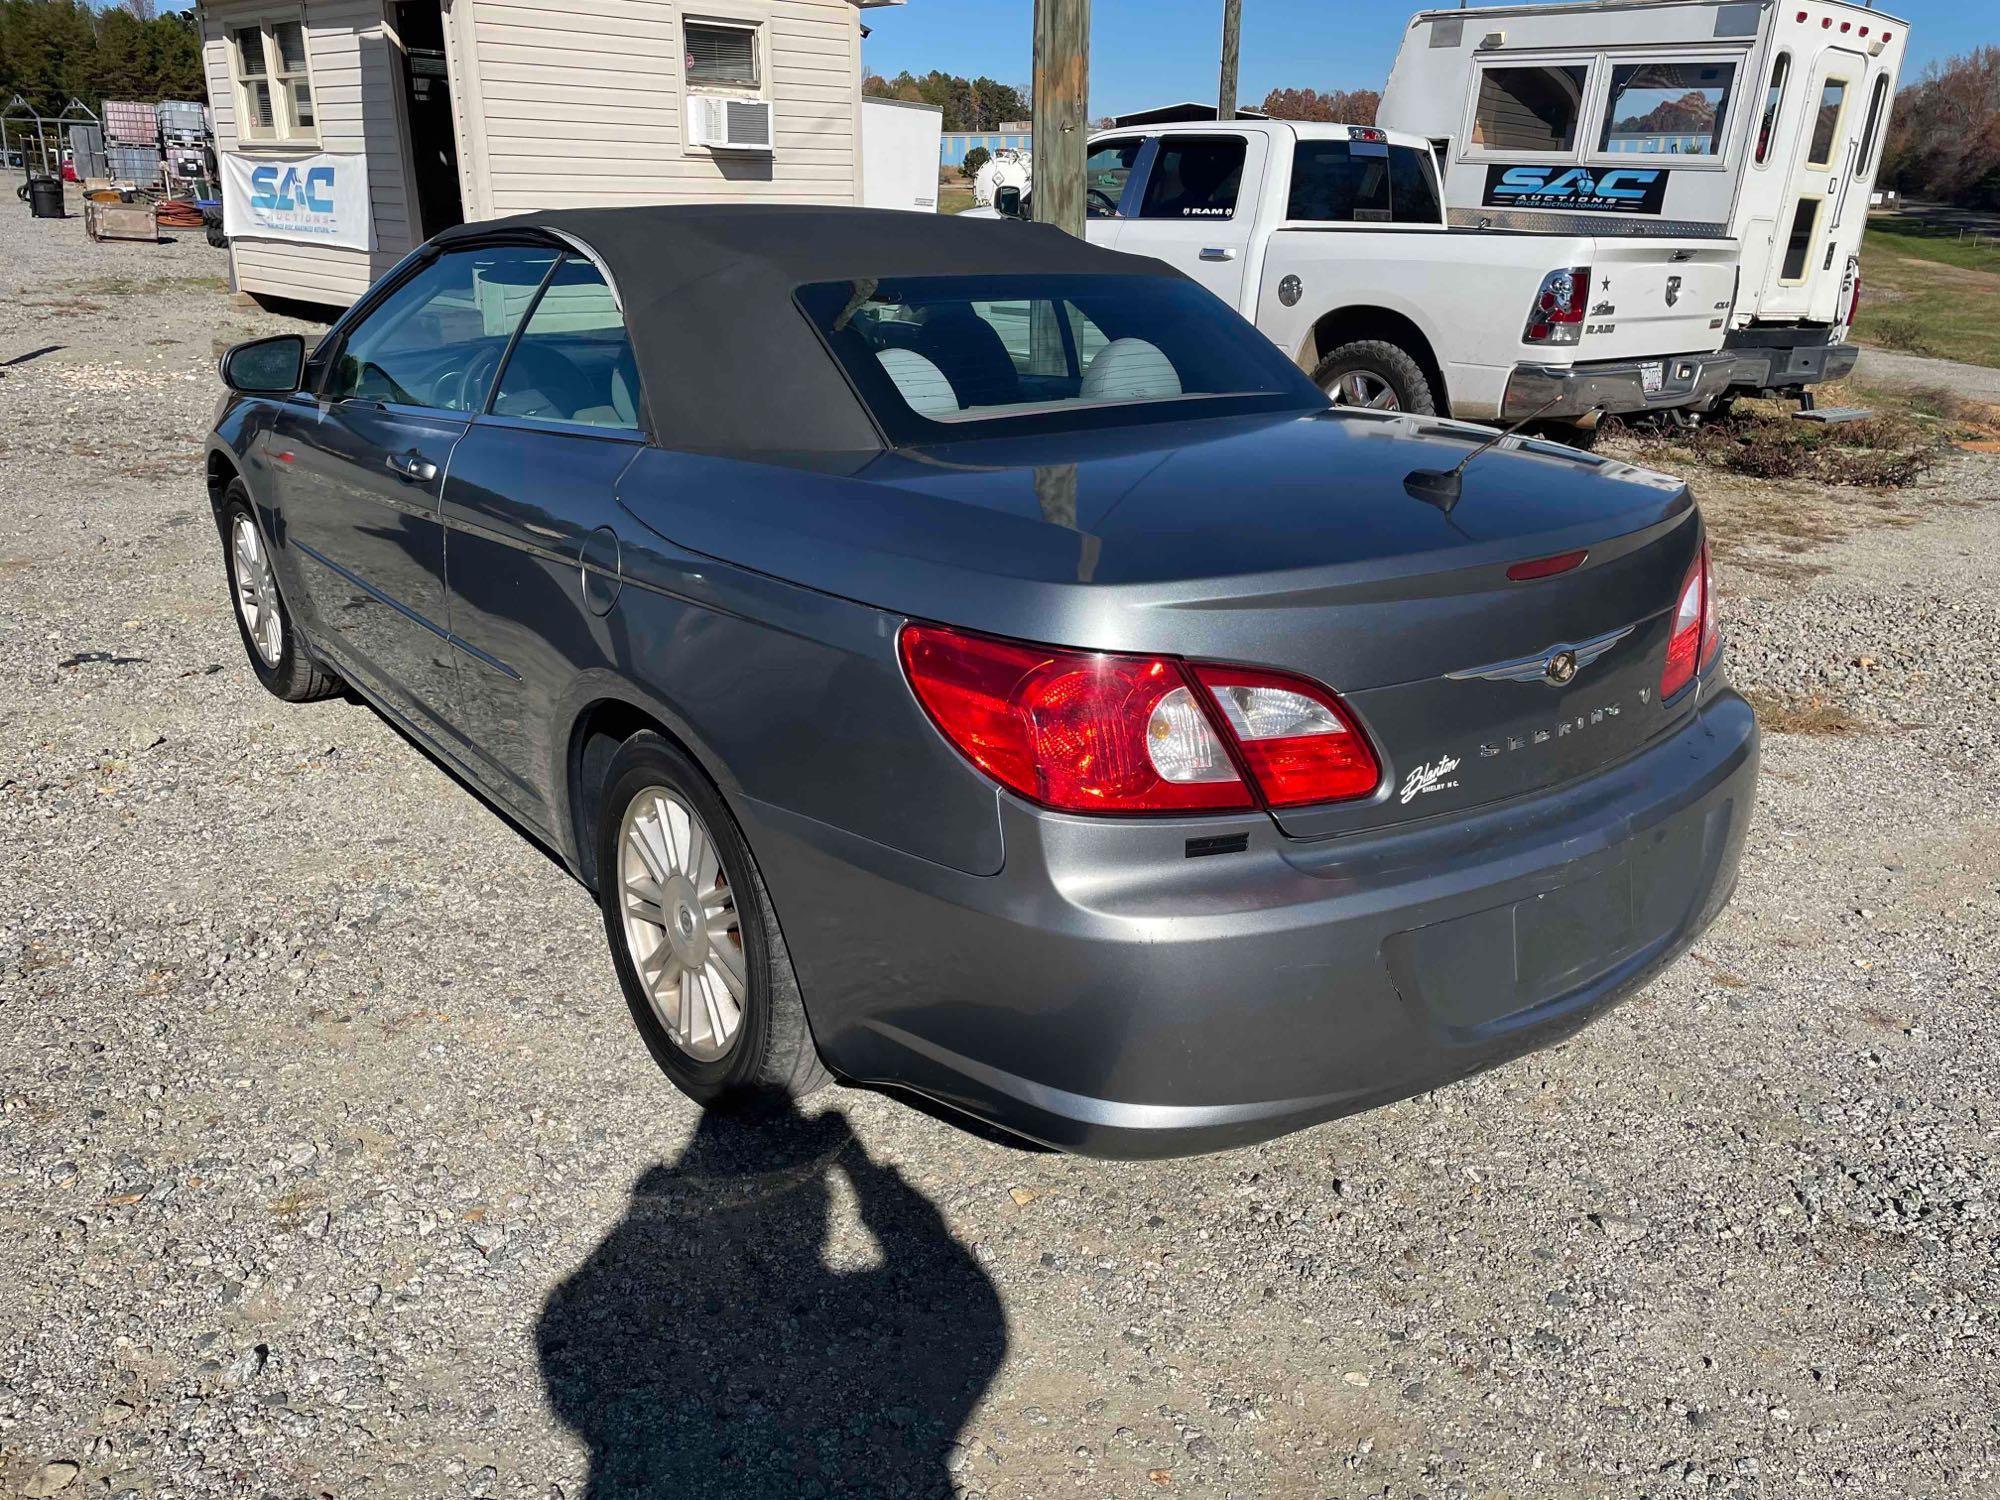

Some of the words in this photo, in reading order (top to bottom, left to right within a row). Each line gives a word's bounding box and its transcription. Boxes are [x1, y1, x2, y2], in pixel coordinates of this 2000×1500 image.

[251, 166, 335, 213] SAC
[1493, 167, 1660, 199] SAC
[1516, 194, 1618, 204] AUCTIONS
[1540, 201, 1575, 209] AUCTION
[1585, 324, 1616, 334] RAM
[1480, 703, 1621, 757] SEBRING
[1400, 754, 1461, 804] Blanton
[1422, 783, 1445, 794] SHELBY
